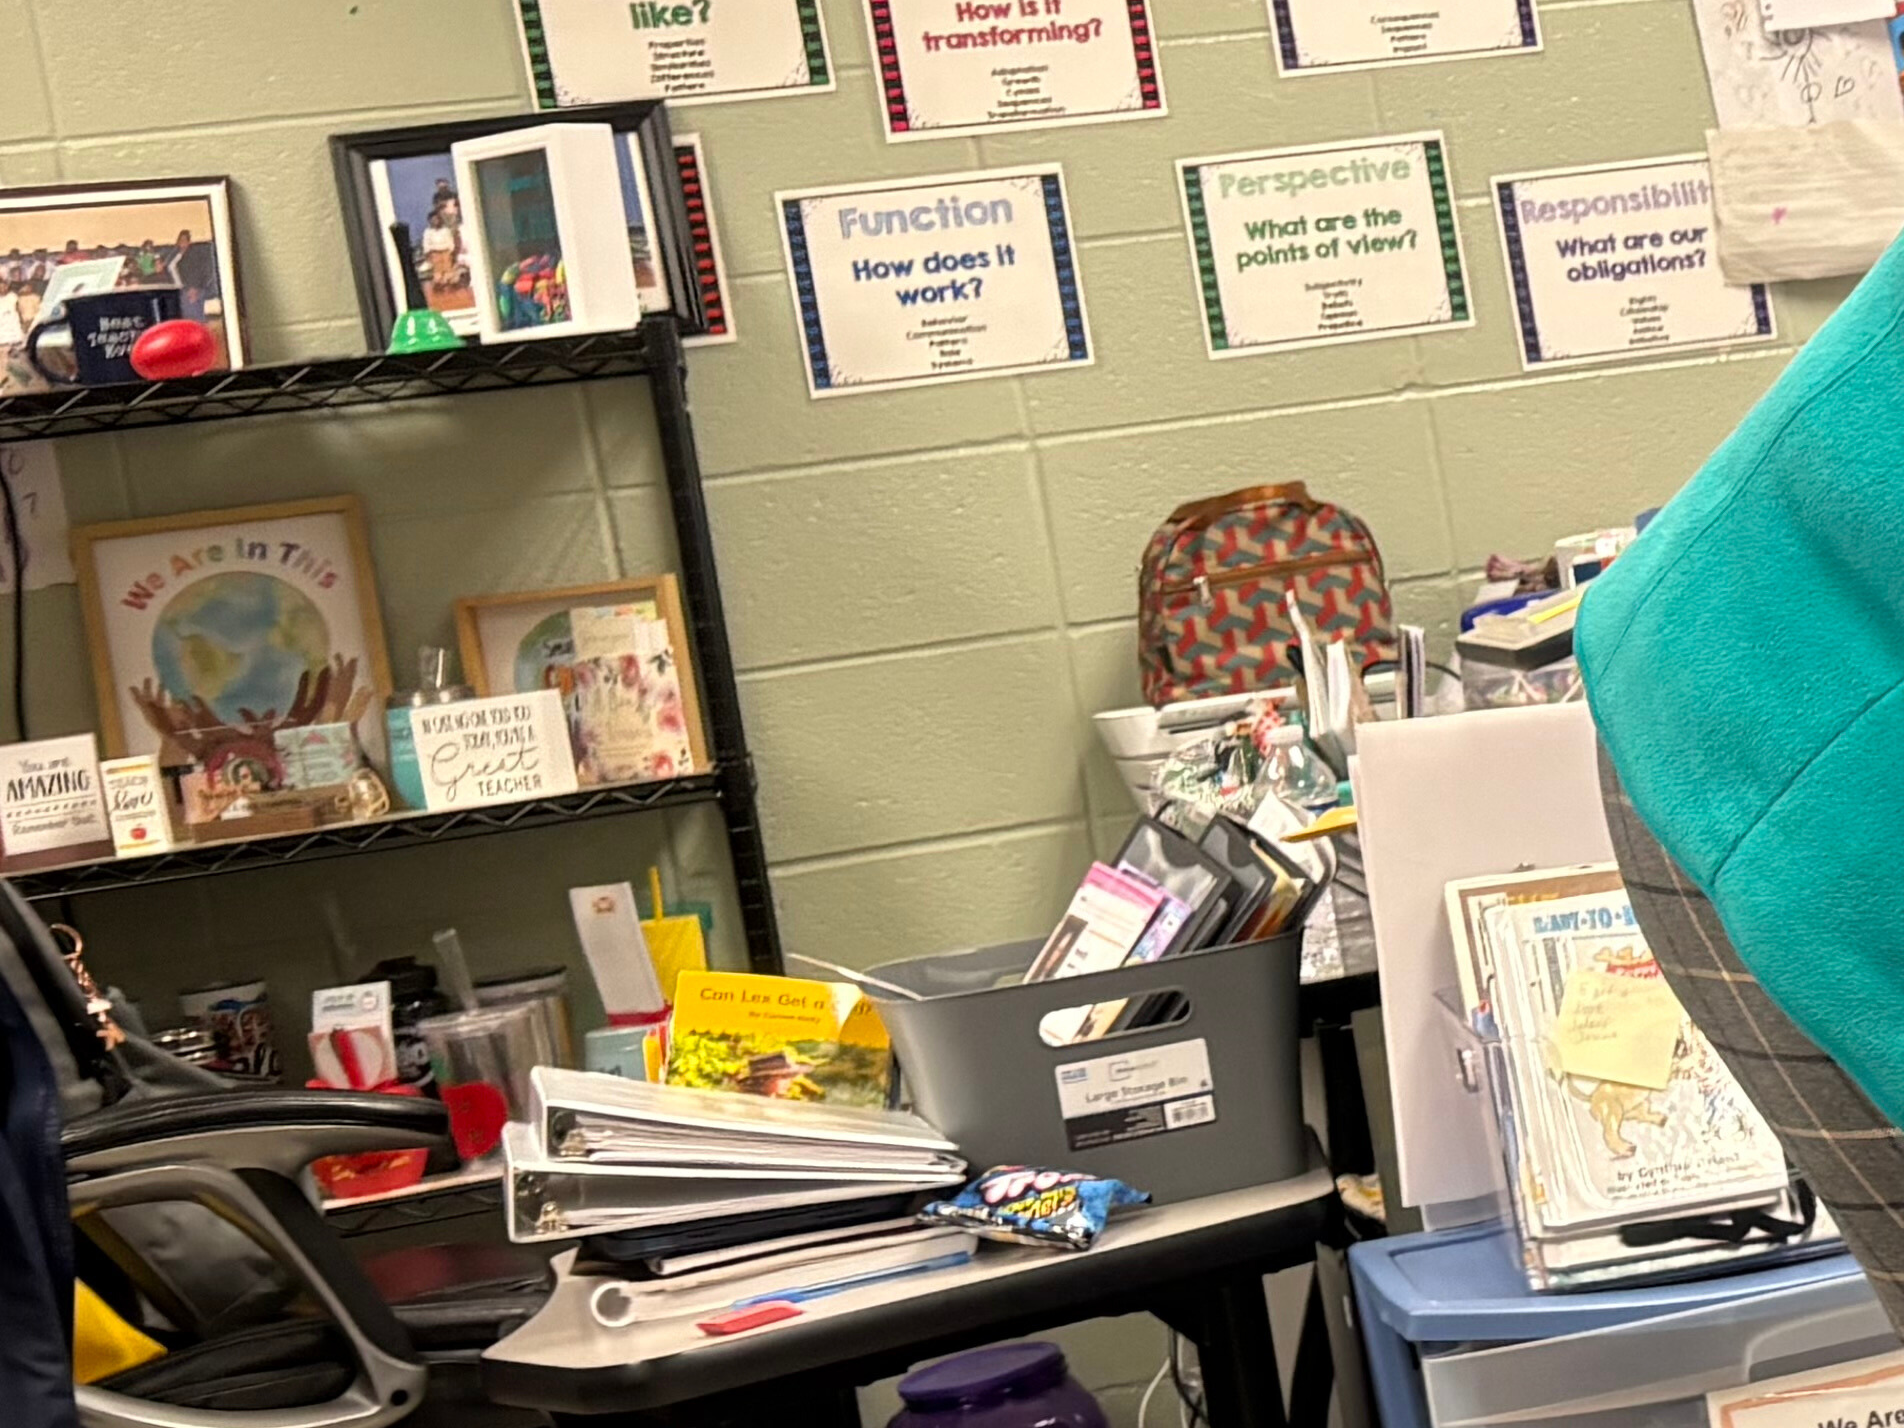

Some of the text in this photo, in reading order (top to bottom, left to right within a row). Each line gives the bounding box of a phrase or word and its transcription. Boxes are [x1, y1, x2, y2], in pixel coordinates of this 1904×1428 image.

[630, 0, 712, 30] like?
[956, 0, 1011, 23] How
[1018, 0, 1039, 17] is
[923, 18, 1102, 53] transforming?
[1219, 154, 1411, 198] Perspective
[838, 196, 1013, 239] Function
[1521, 181, 1709, 225] Responsibilit
[1244, 207, 1401, 241] What are the
[1236, 230, 1417, 272] points of view?
[1556, 228, 1708, 259] What are our
[853, 244, 1015, 282] How does it
[1566, 250, 1707, 282] obligations?
[896, 277, 983, 306] work?
[120, 538, 338, 610] We Are In This
[6, 769, 90, 802] AMAZING
[479, 774, 542, 797] TEACHER
[1086, 1076, 1188, 1103] Large Storage Bin
